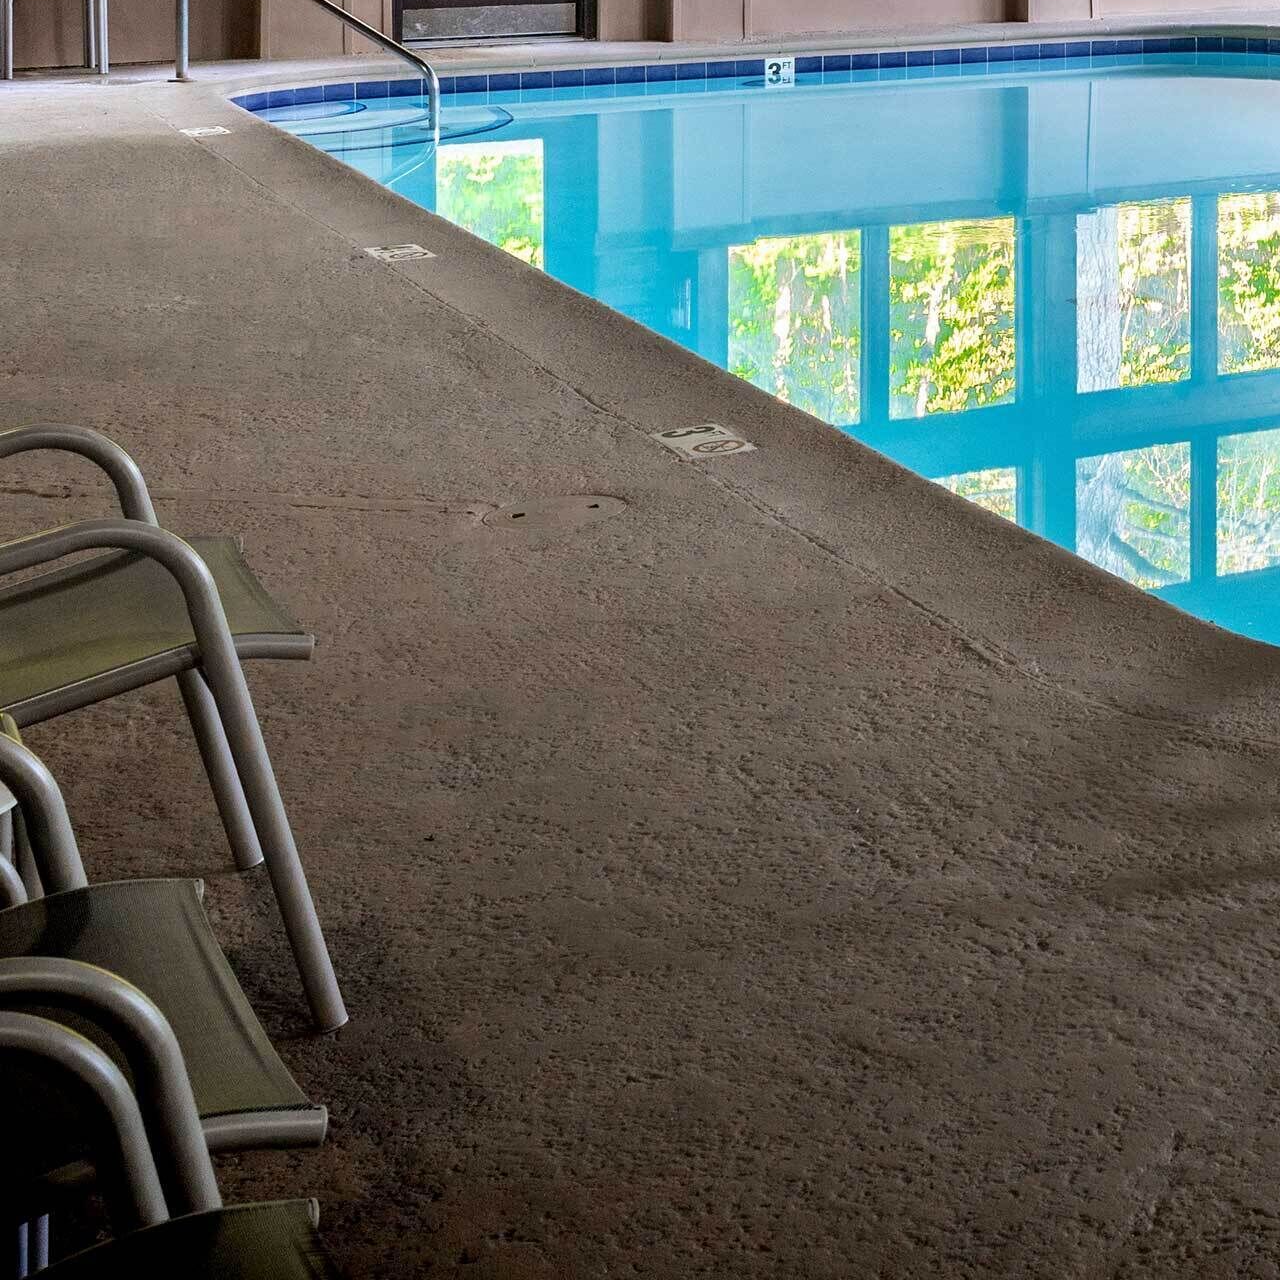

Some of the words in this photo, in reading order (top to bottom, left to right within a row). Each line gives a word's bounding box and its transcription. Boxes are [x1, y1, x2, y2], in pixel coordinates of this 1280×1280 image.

[768, 62, 782, 84] 3
[782, 61, 792, 69] FT
[661, 426, 716, 438] 3
